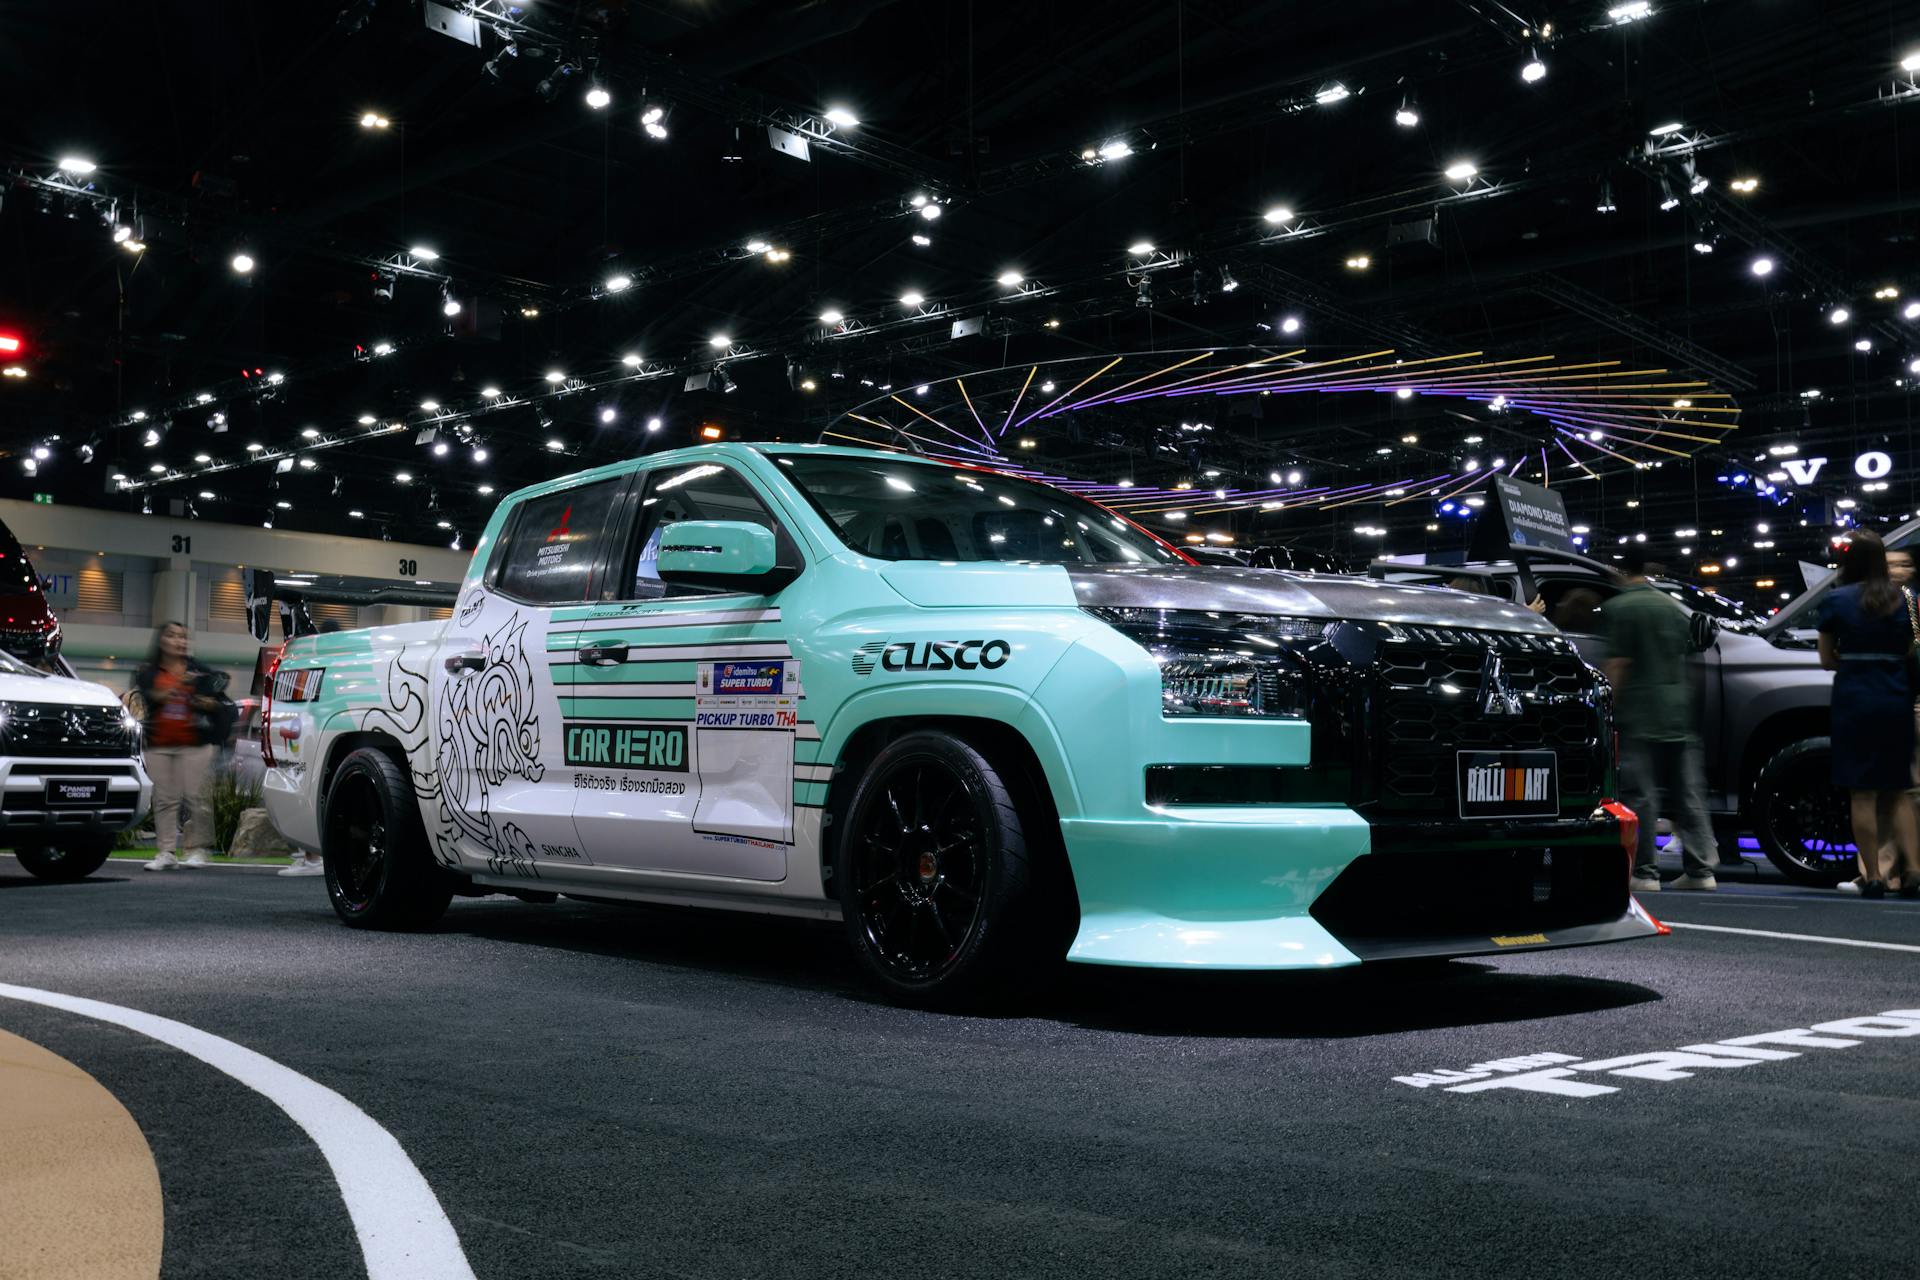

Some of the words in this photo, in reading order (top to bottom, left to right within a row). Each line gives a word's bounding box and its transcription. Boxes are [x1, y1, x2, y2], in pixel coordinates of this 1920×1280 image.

[1508, 499, 1543, 519] DIAMOND
[1542, 509, 1565, 526] SENSE
[171, 534, 192, 554] 31
[537, 543, 571, 557] MITSUBISHI
[399, 559, 418, 576] 30
[538, 554, 563, 567] MOTORS
[38, 574, 72, 594] XIT
[720, 678, 746, 688] SUPER
[747, 678, 773, 688] TURBO
[697, 713, 737, 726] PICKUP
[740, 713, 775, 726] TURBO
[776, 711, 797, 727] THA
[568, 728, 610, 763] CAR
[615, 729, 683, 766] HERO
[60, 785, 96, 793] XPANDER
